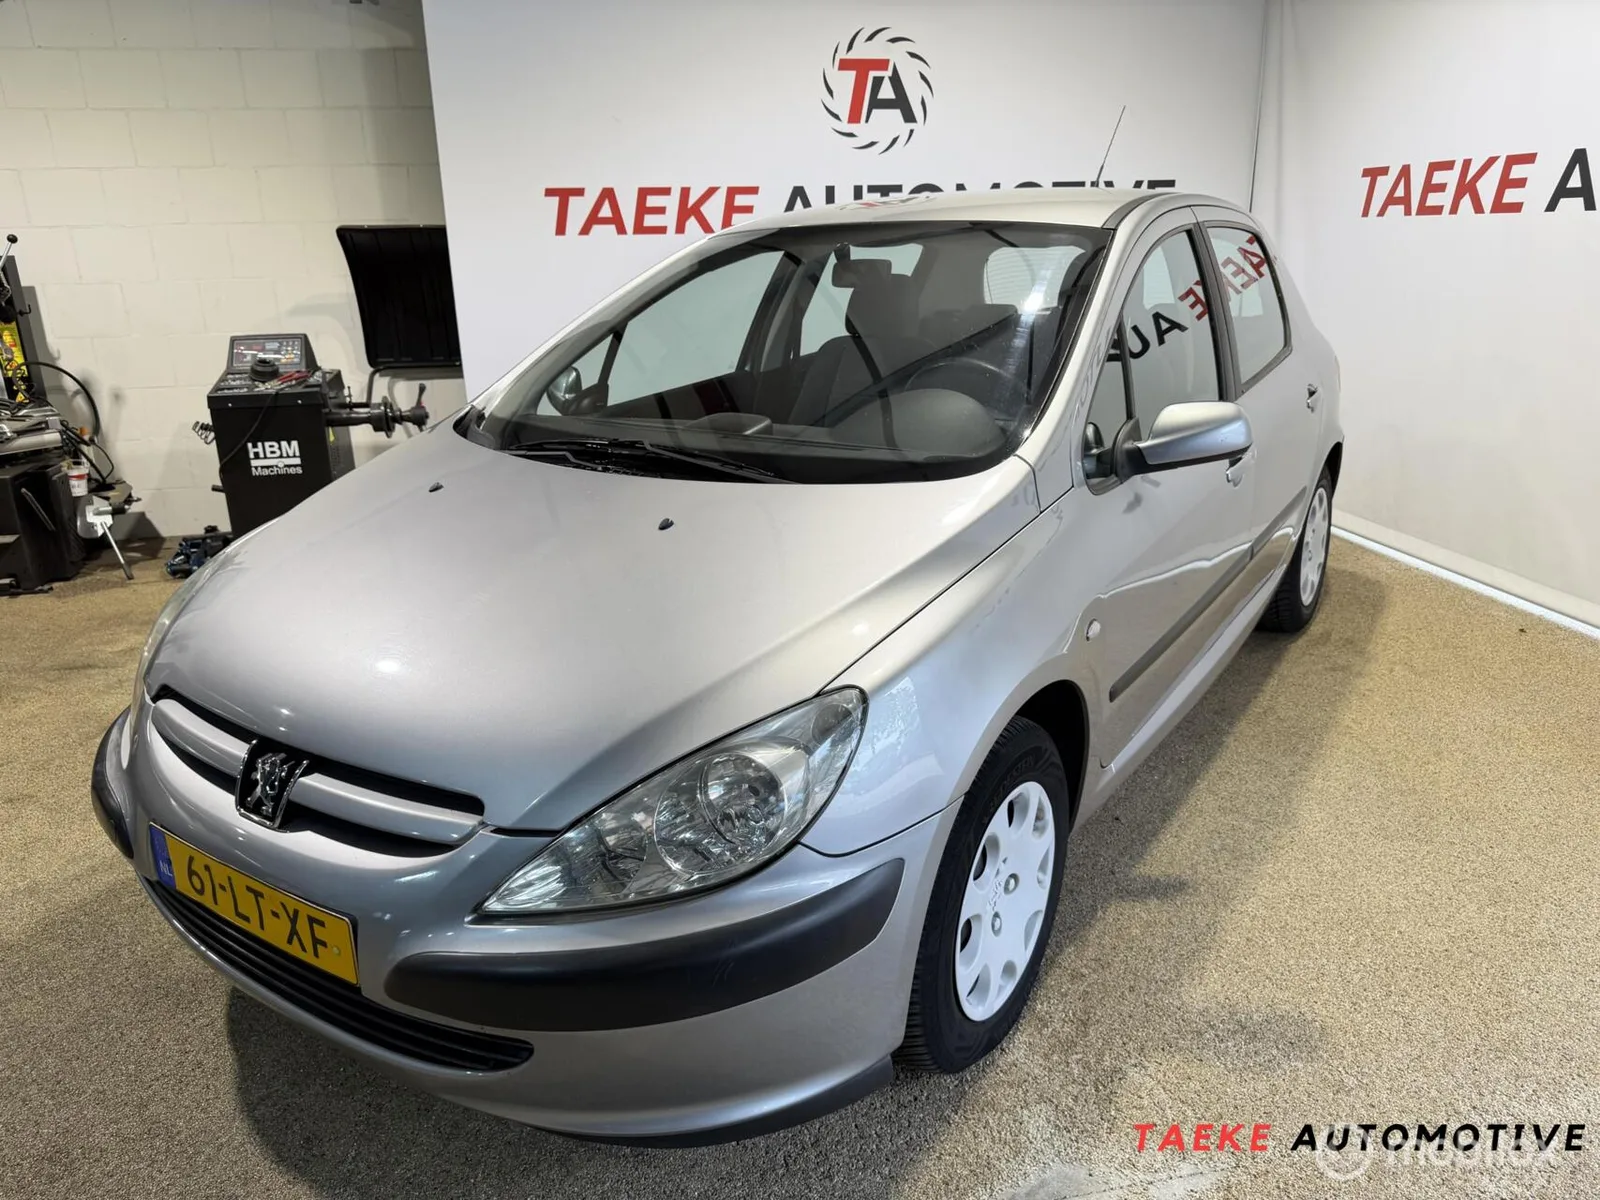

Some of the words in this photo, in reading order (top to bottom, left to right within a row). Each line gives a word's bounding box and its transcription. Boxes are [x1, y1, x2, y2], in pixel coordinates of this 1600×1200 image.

[836, 57, 918, 125] TA
[1360, 152, 1538, 218] TAEKE
[1543, 147, 1597, 213] A
[544, 185, 760, 237] TAEKE
[246, 440, 301, 459] HBM
[251, 466, 303, 477] Machines
[159, 860, 173, 877] NL
[186, 855, 329, 960] 61-LT-XF
